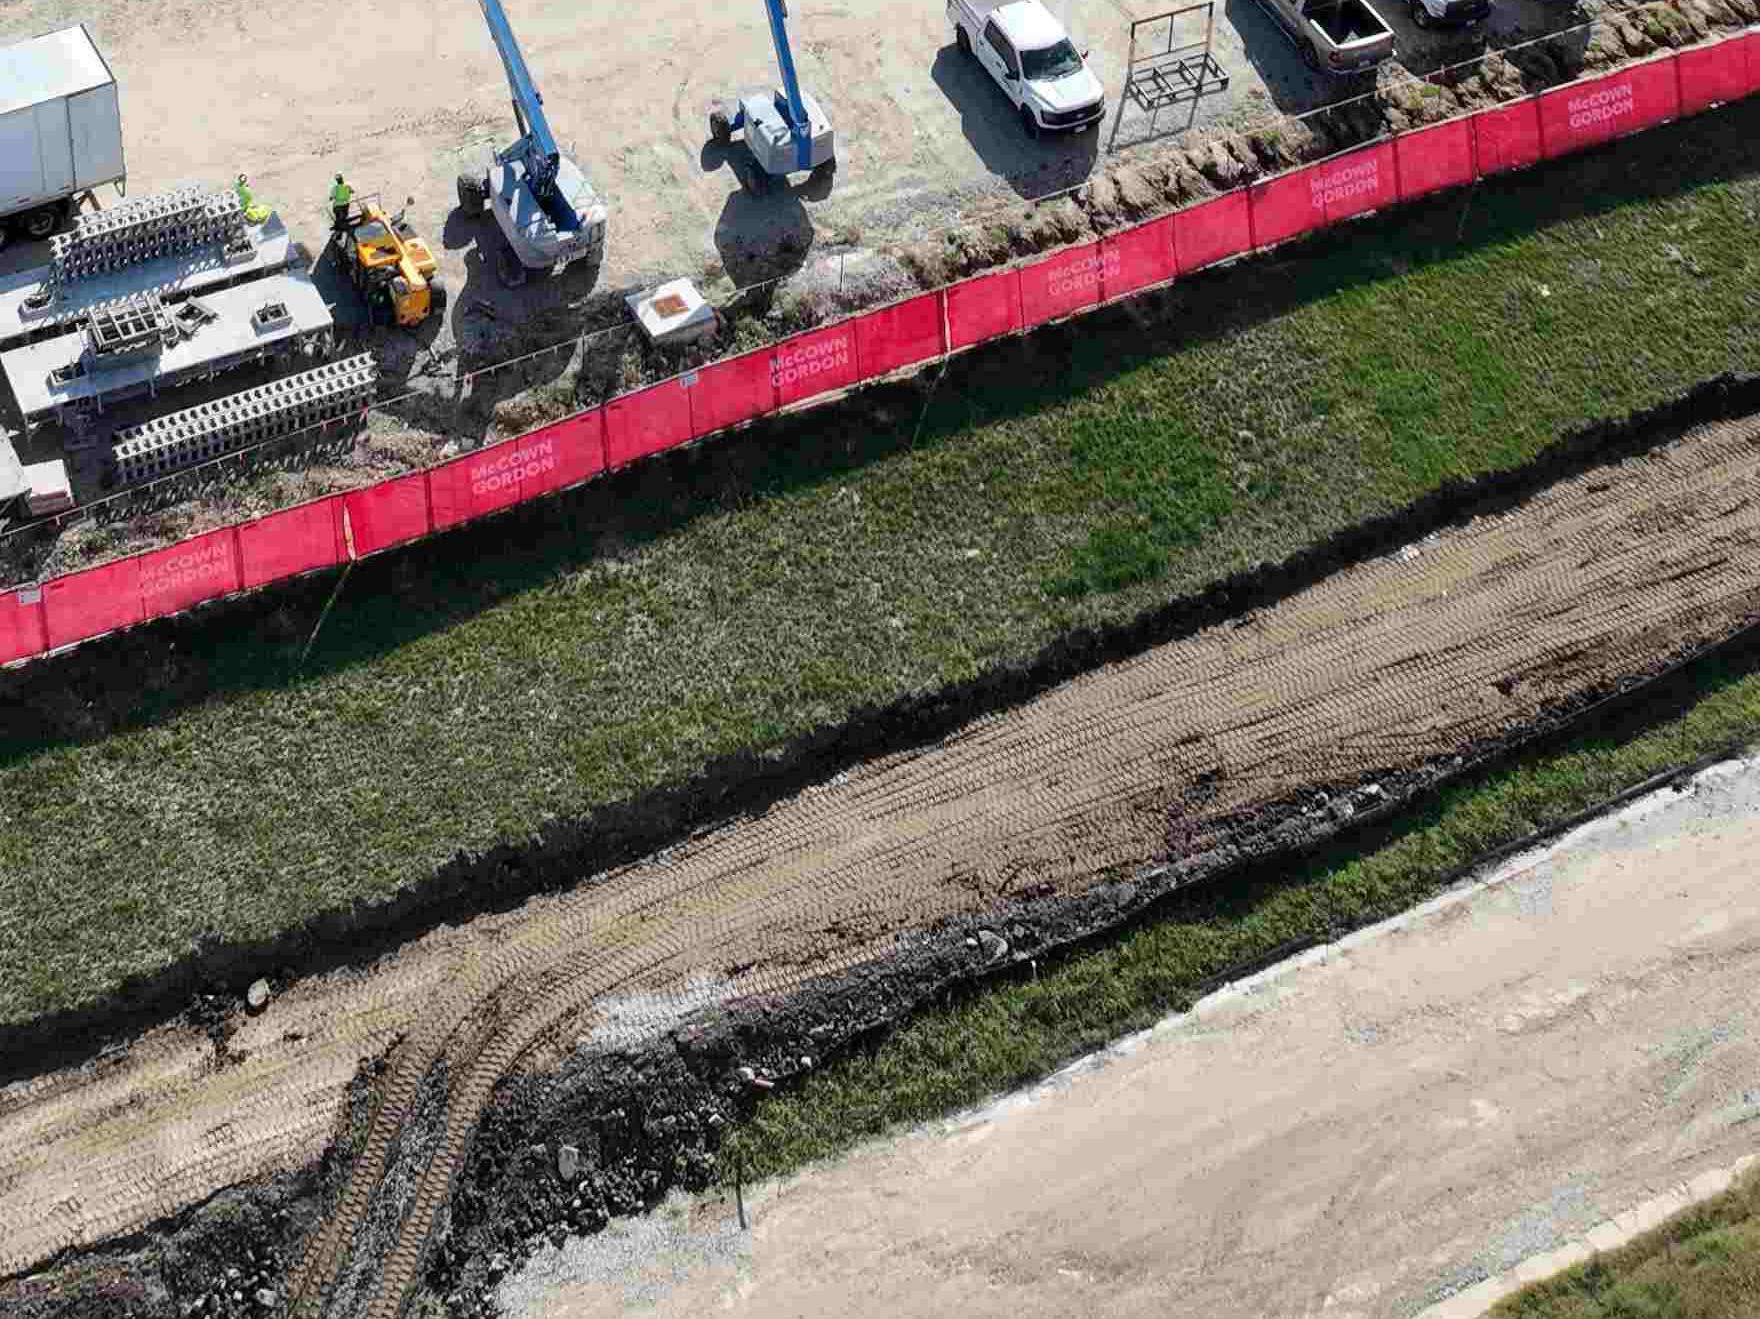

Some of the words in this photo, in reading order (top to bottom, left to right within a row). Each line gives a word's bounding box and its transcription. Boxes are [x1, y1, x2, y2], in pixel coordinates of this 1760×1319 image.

[1568, 83, 1632, 113] McCOWN
[1569, 99, 1632, 129] GORDON
[1312, 178, 1378, 210] GORDON
[1048, 265, 1120, 296] GORDON
[769, 336, 848, 372] McCOWN
[770, 351, 849, 388] GORDON
[471, 437, 553, 481] McCOWN
[472, 455, 555, 495] GORDON
